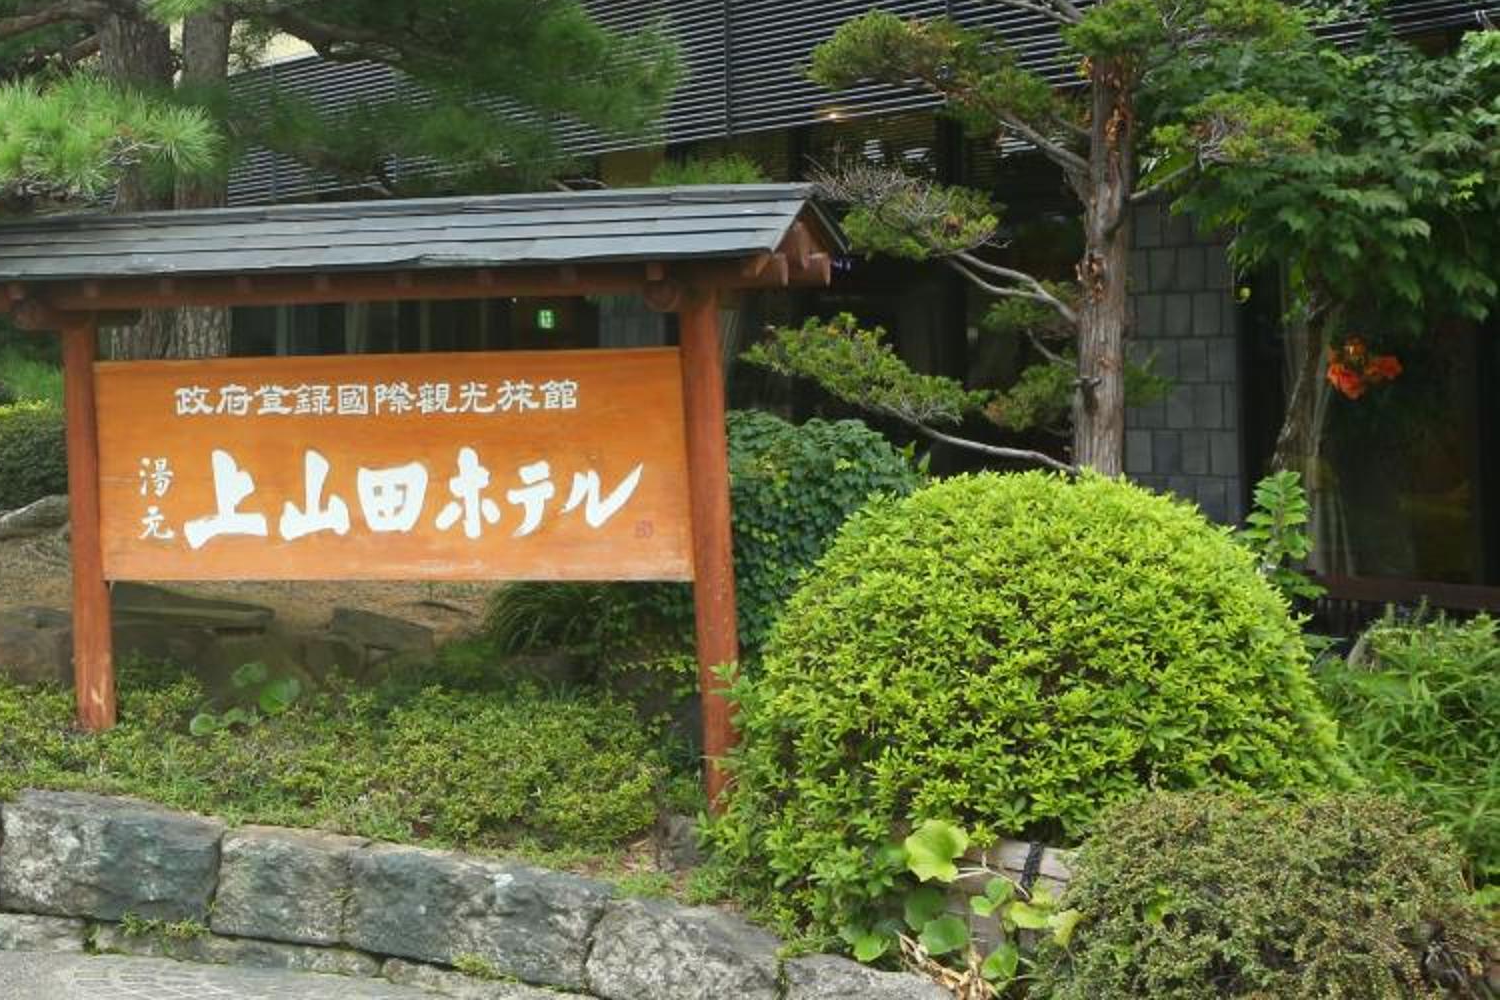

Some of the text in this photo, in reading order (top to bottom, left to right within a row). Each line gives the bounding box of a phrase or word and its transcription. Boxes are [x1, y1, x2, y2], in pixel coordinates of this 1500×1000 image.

[138, 457, 174, 540] 湯元
[184, 446, 644, 549] 上山田ホテル
